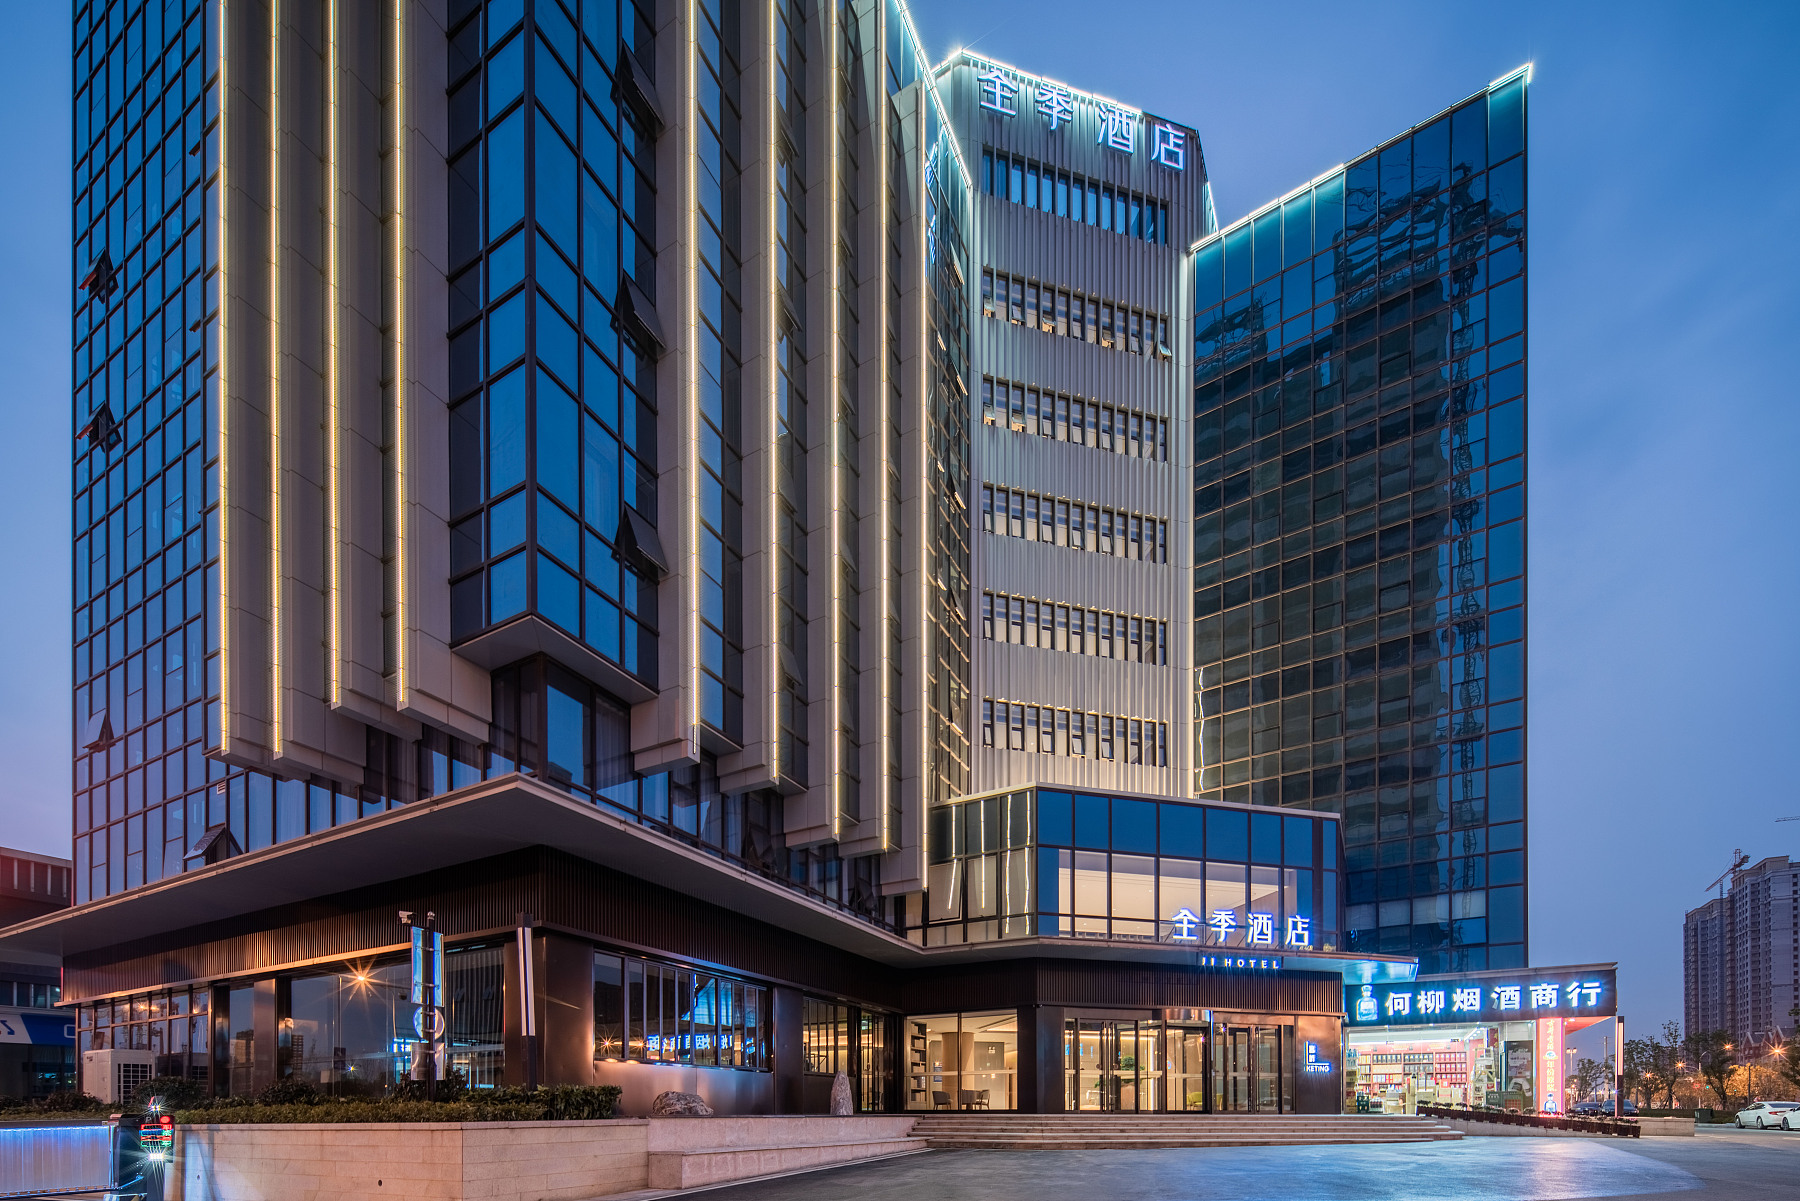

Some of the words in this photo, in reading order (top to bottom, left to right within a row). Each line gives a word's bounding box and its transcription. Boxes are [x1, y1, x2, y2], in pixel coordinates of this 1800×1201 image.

[977, 69, 1186, 171] 全季酒店
[1171, 908, 1310, 946] 全季酒店
[1201, 956, 1216, 966] JI
[1224, 958, 1280, 969] HOTEL
[1385, 981, 1602, 1016] 何柳烟酒商行
